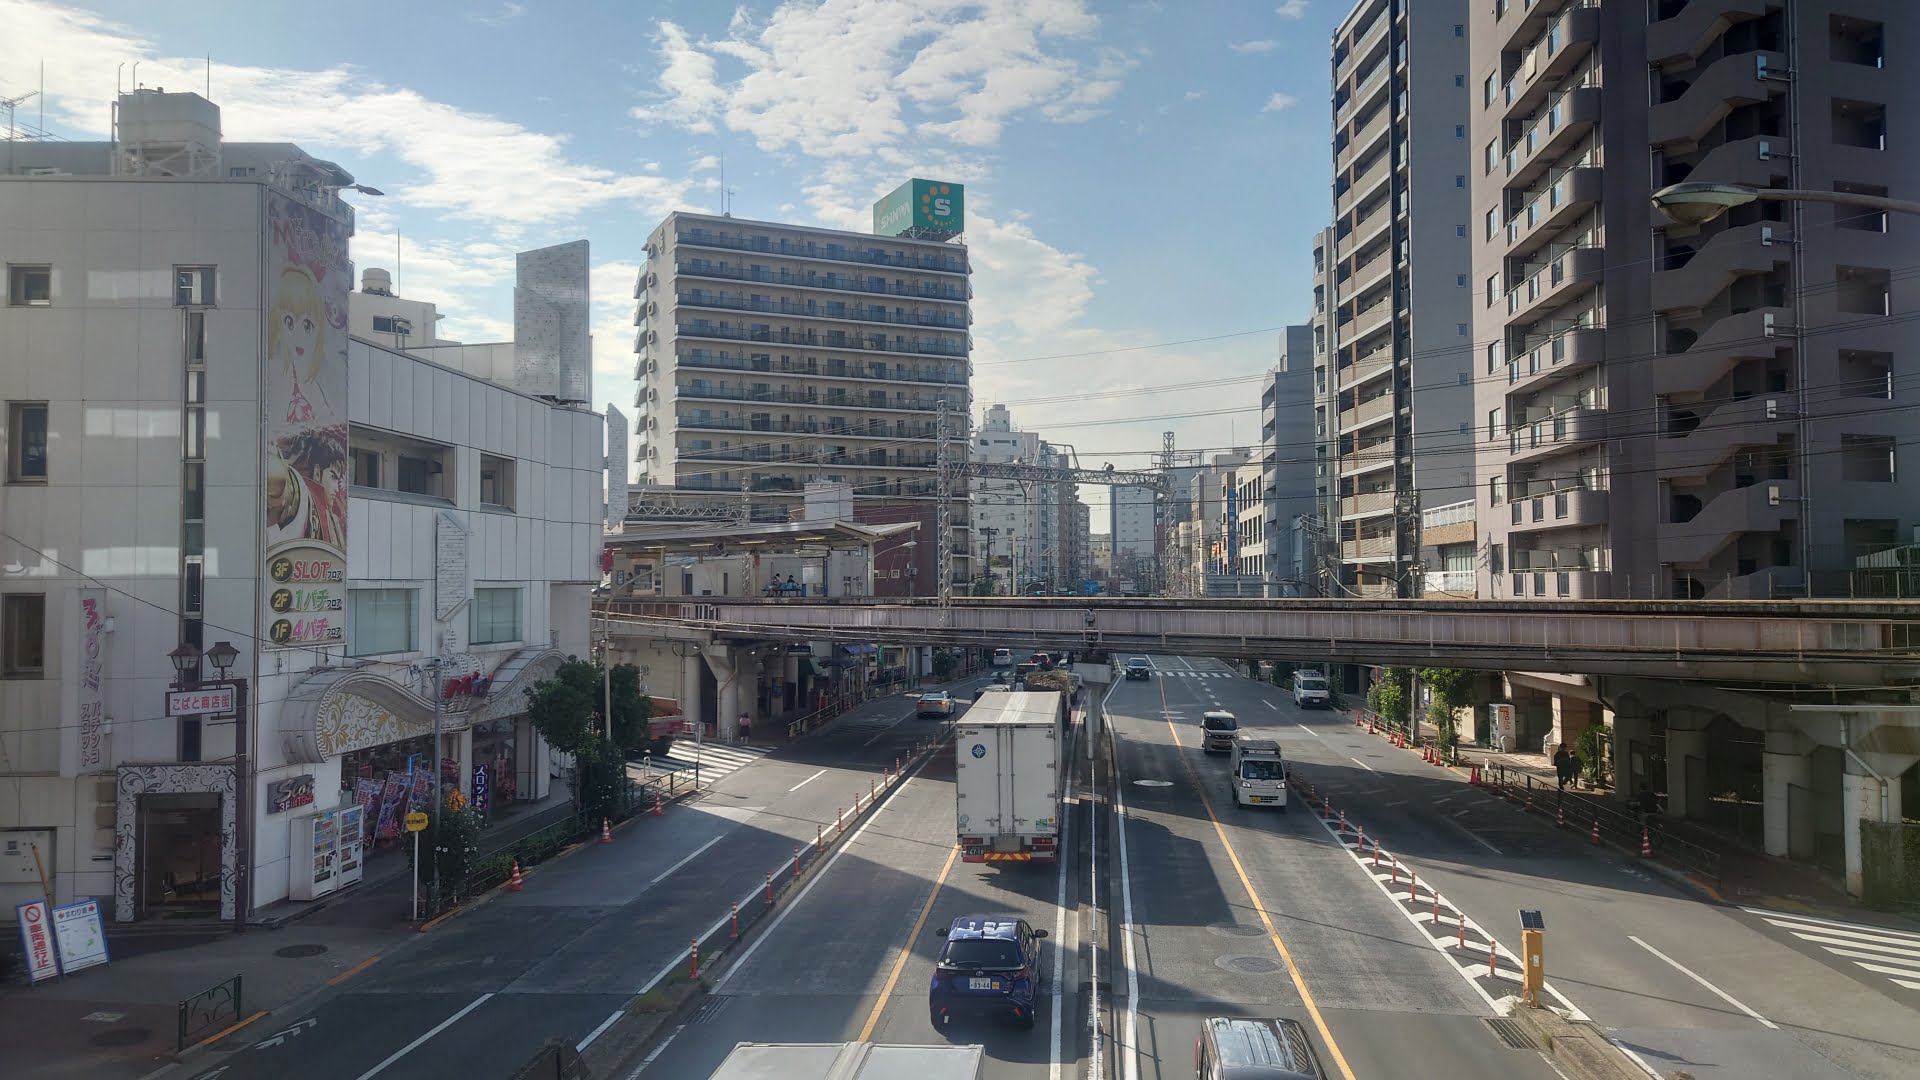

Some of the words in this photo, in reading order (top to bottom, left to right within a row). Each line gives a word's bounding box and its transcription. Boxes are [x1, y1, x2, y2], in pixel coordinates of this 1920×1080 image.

[274, 562, 289, 577] 3F
[274, 592, 289, 608] 2F
[275, 623, 289, 639] 1F
[172, 694, 230, 711] こばと商店街
[80, 703, 91, 767] スロット
[90, 701, 102, 765] パチンコ
